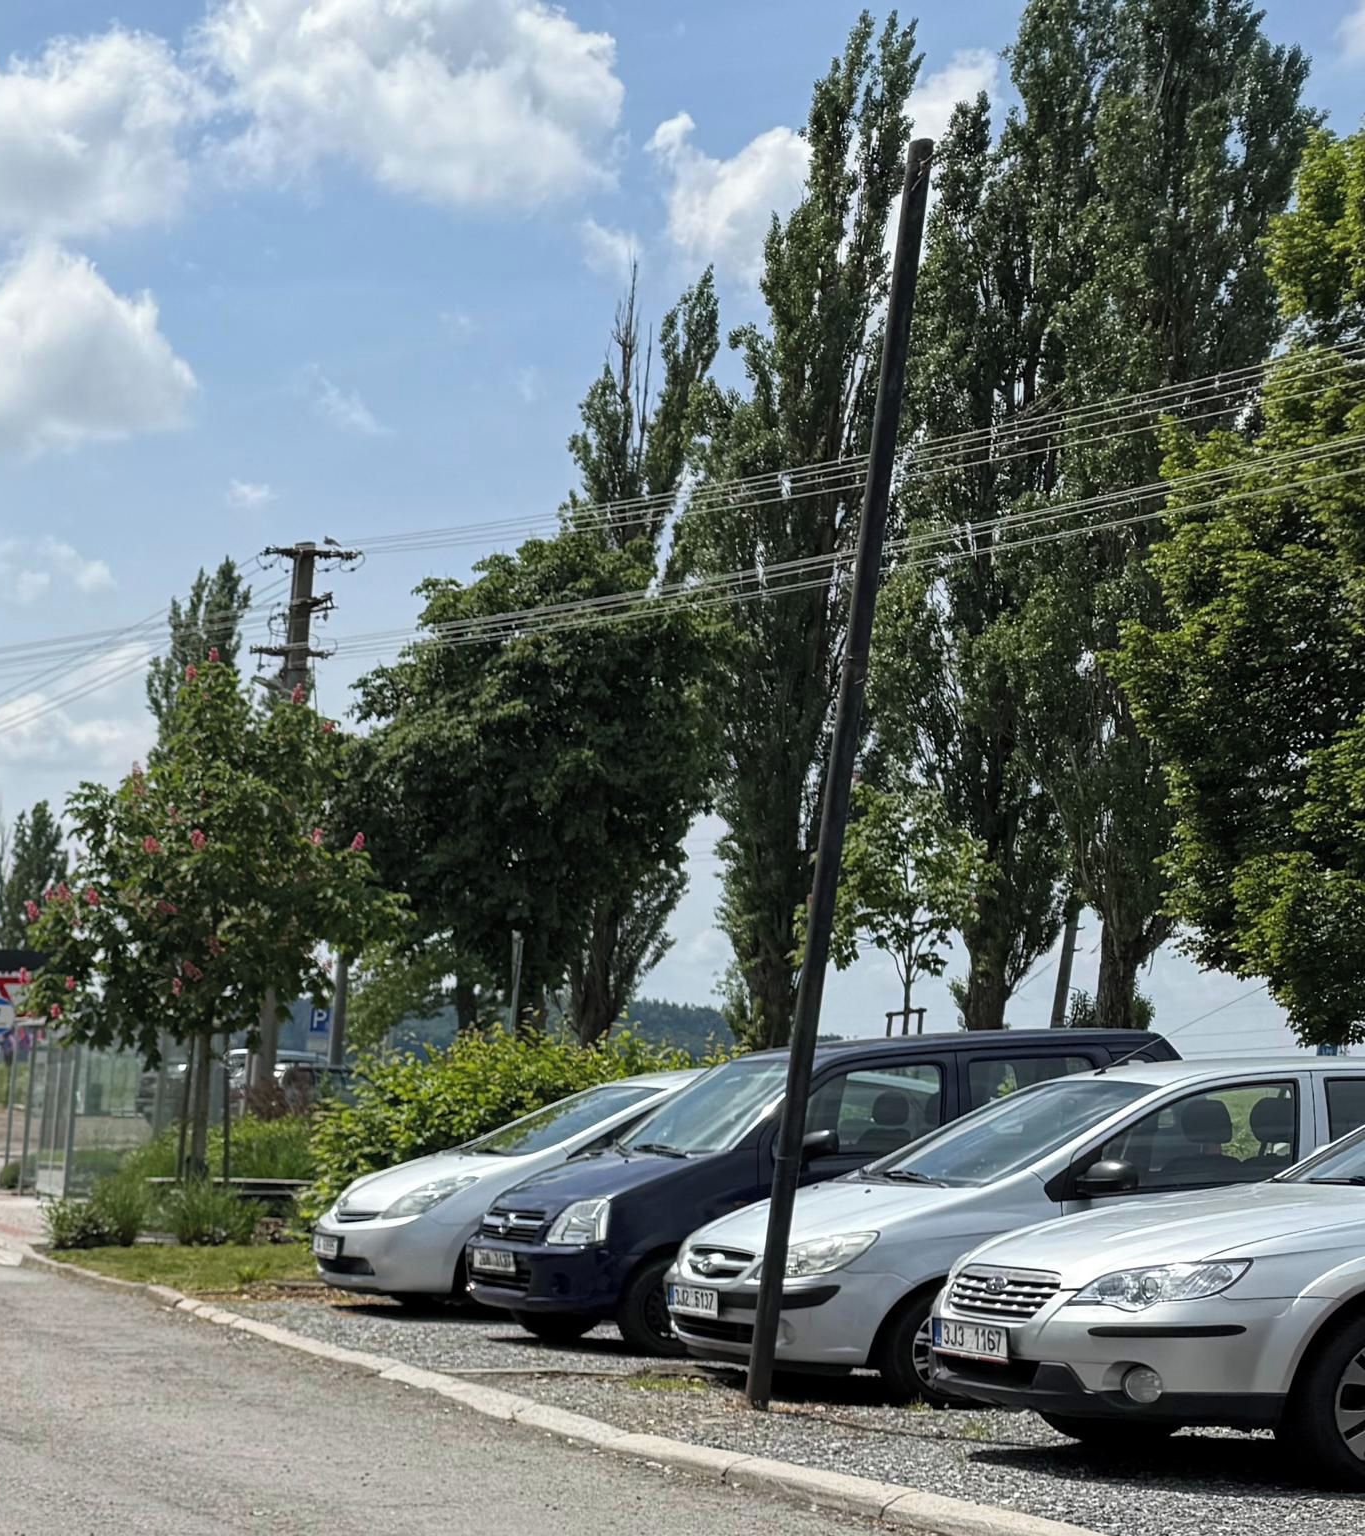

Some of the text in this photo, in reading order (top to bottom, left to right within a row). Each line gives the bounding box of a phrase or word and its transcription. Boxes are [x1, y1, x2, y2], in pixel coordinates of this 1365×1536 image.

[313, 1009, 328, 1028] P
[943, 1324, 1002, 1353] 3J3 1167
